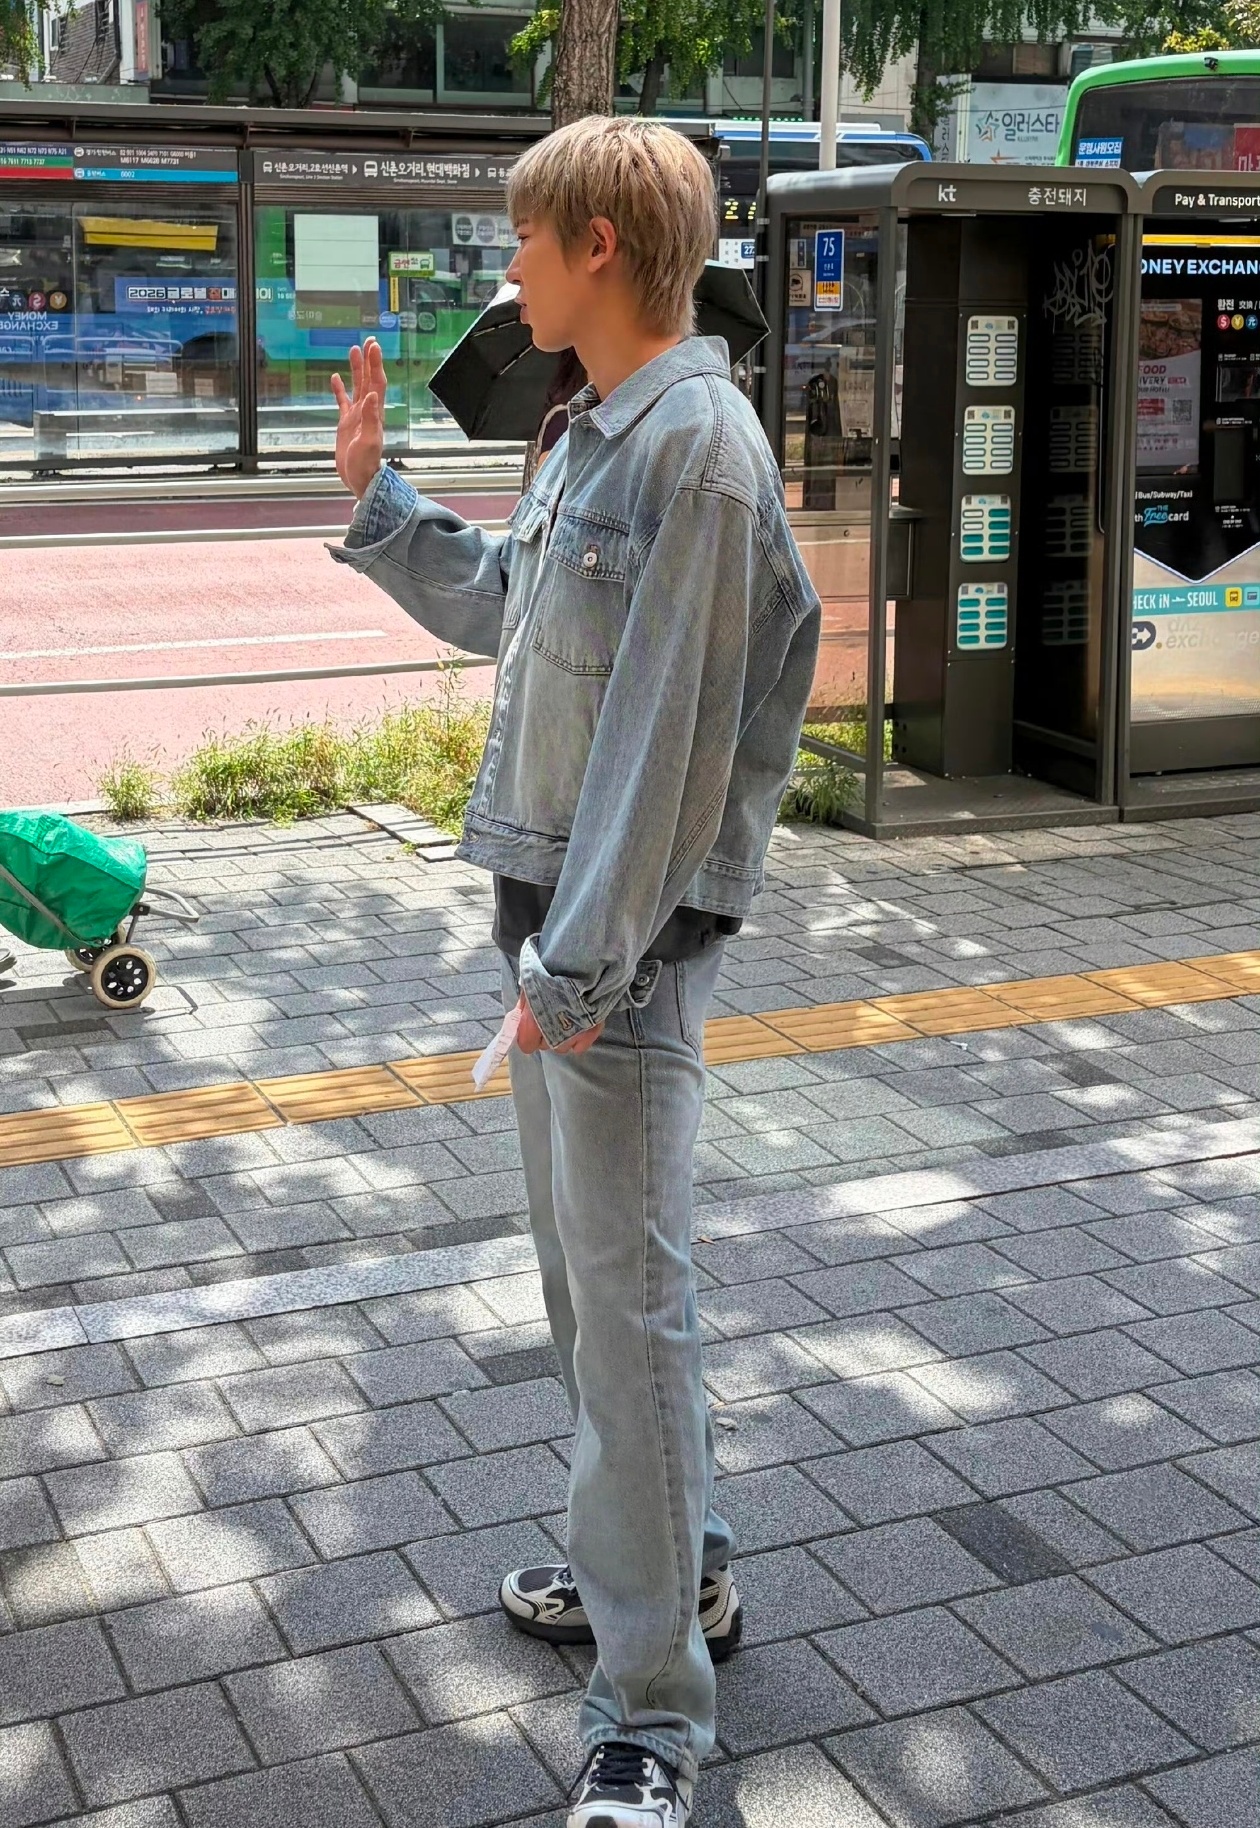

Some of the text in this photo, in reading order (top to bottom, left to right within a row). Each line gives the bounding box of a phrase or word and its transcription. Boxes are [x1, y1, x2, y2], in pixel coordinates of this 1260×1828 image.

[1002, 112, 1060, 142] 일러스타
[938, 184, 957, 202] kt
[1028, 187, 1087, 206] 충전돼지
[1175, 194, 1260, 208] Pay & Transport
[744, 246, 755, 254] 27
[822, 237, 835, 257] 75
[1141, 259, 1260, 274] ONEY EXCHAN
[130, 289, 164, 298] 2026
[1139, 376, 1166, 385] IVERY
[1144, 507, 1168, 526] Free
[1168, 511, 1189, 522] card
[1133, 594, 1156, 610] HECK
[1187, 591, 1218, 607] SEOUL
